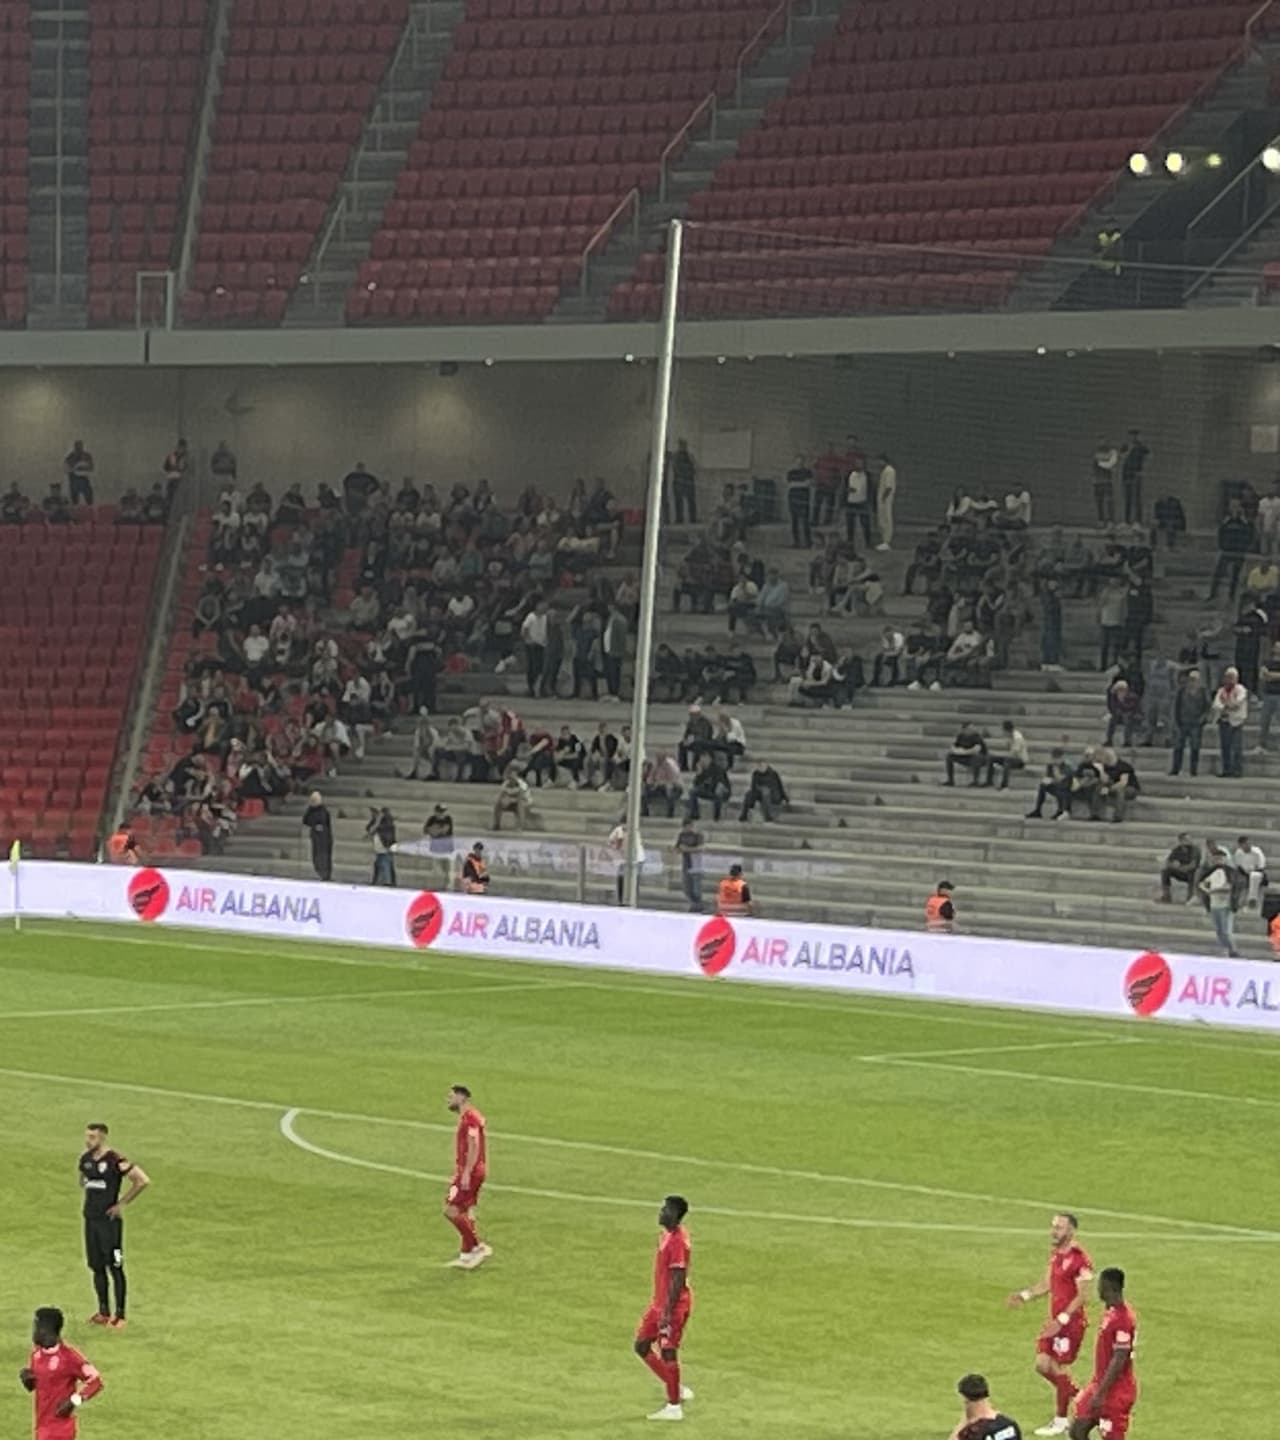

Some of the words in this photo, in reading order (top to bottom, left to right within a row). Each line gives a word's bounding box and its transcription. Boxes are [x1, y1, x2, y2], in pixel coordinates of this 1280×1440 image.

[175, 886, 216, 913] AIR
[220, 890, 322, 924] ALBANIA
[448, 911, 488, 940] AIR
[493, 915, 600, 950] ALBANIA
[741, 937, 789, 967] AIR
[792, 941, 915, 978] ALBANIA
[1178, 975, 1232, 1007] AIR
